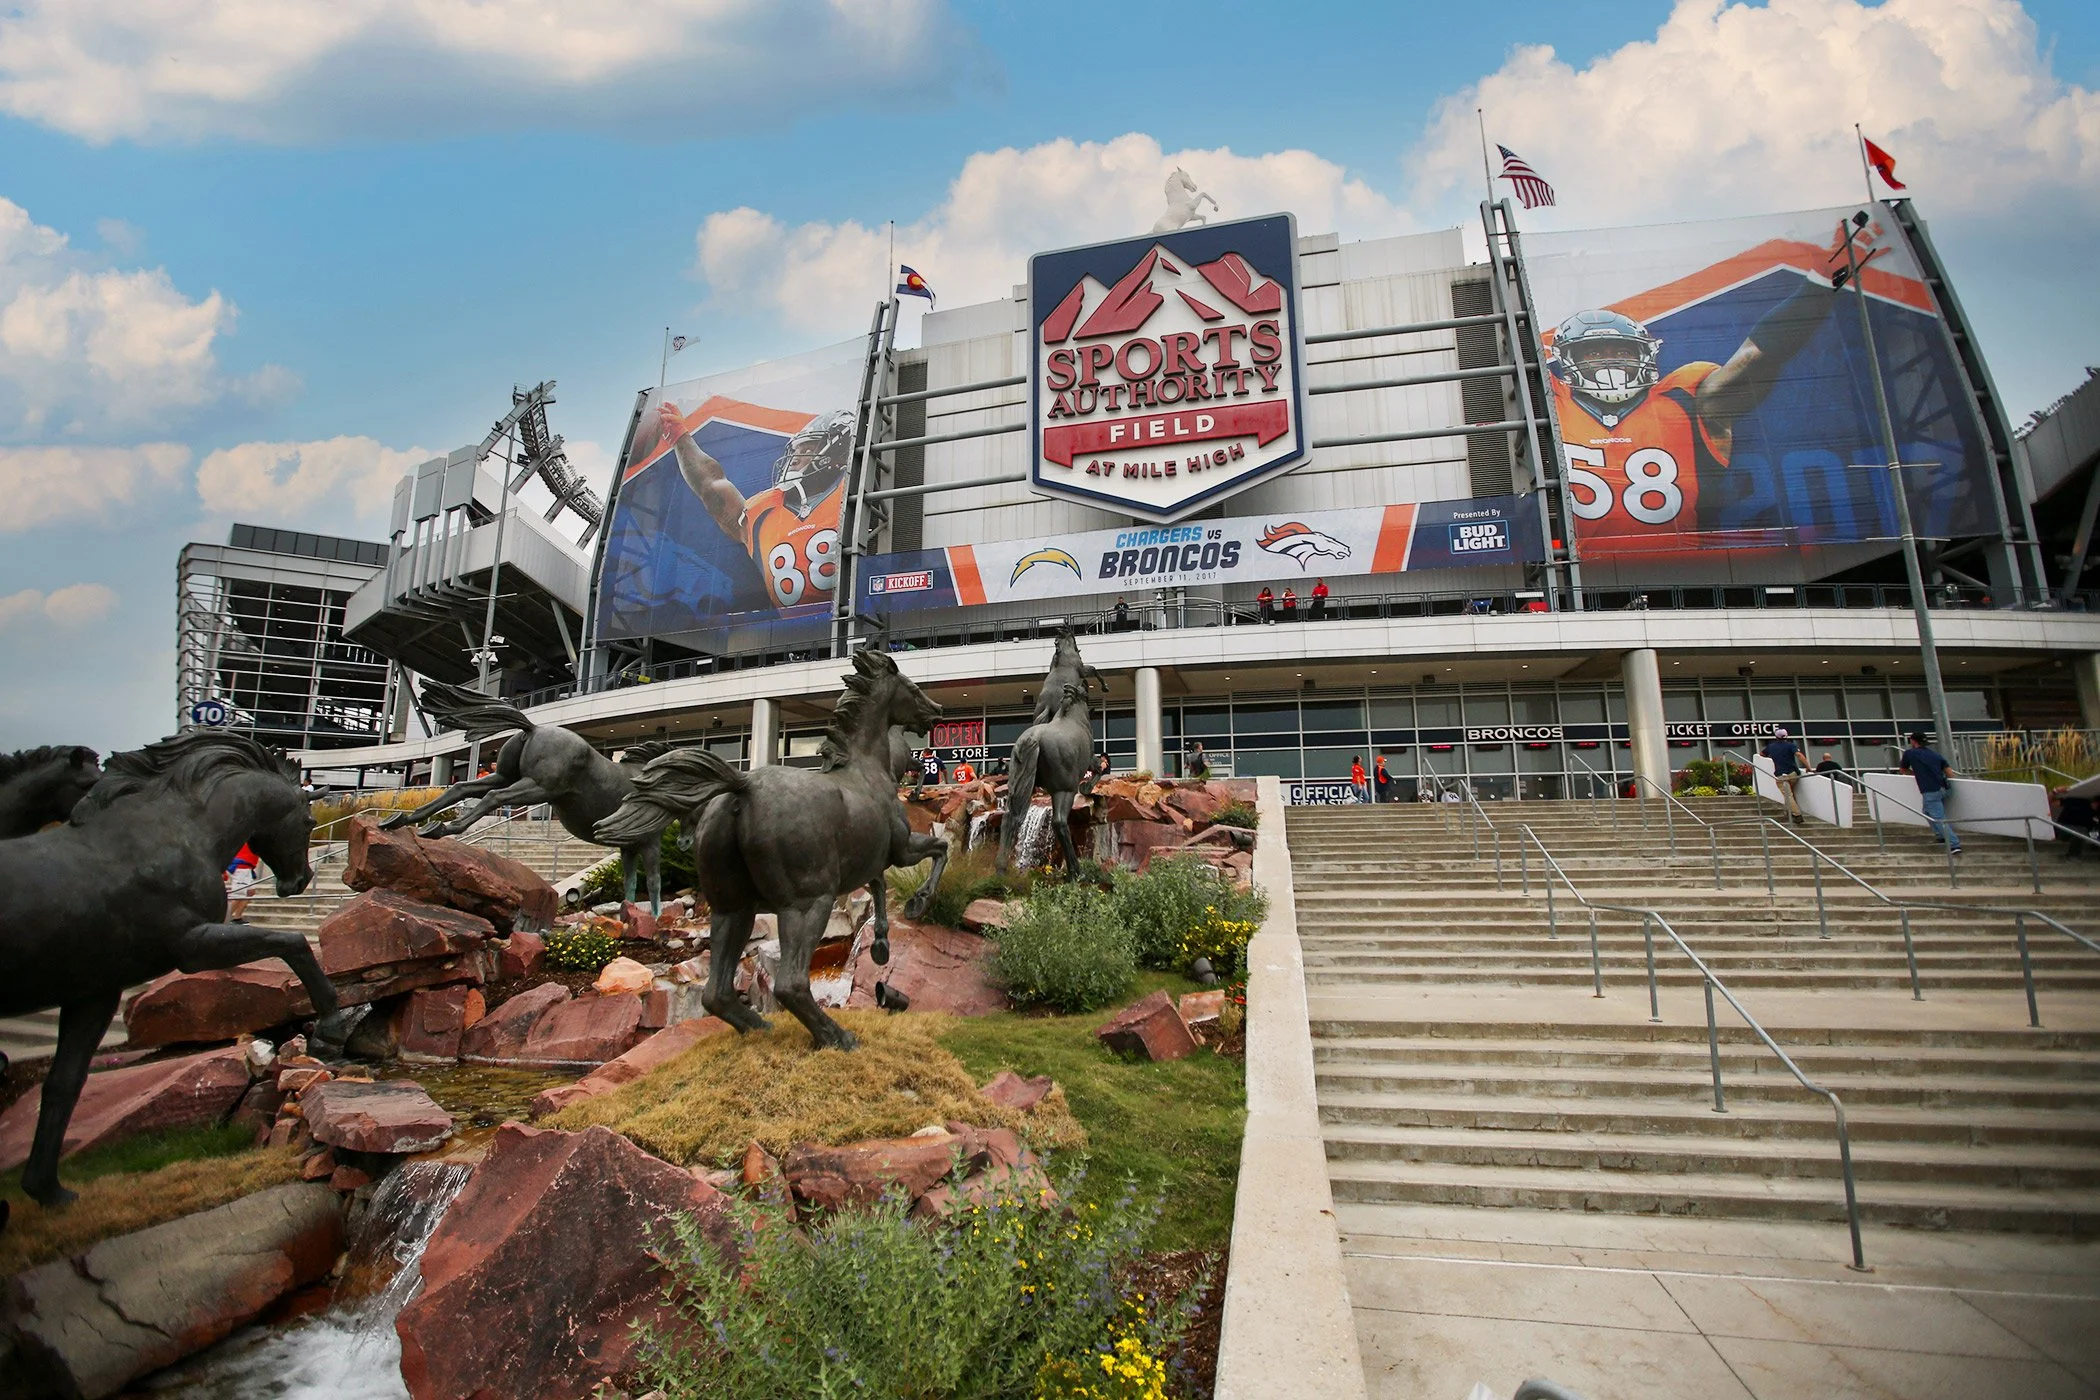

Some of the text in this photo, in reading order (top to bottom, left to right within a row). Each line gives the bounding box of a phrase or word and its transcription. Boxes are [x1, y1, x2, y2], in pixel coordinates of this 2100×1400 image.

[1046, 319, 1283, 391] SPORTS
[1047, 363, 1283, 419] AUTHORITY
[1110, 414, 1216, 443] FIELD
[1085, 442, 1245, 478] AT MILE HIGH
[1562, 442, 1684, 525] 58
[1453, 508, 1501, 519] Presented By
[1116, 526, 1222, 549] CHARGERS VS
[1460, 524, 1498, 539] BUD
[1453, 535, 1506, 551] LIGHT
[768, 528, 838, 607] 88
[1099, 540, 1242, 579] BRONCOS
[888, 575, 925, 589] KICKOFF
[1124, 571, 1217, 586] SEPTEMBER 11, 2017
[196, 706, 223, 722] 10
[934, 721, 984, 747] OPEN
[1467, 723, 1780, 740] BRONCOS TICKET OFFICE
[952, 747, 989, 759] STORE
[924, 762, 938, 775] 58
[1292, 785, 1355, 799] OFFICIA
